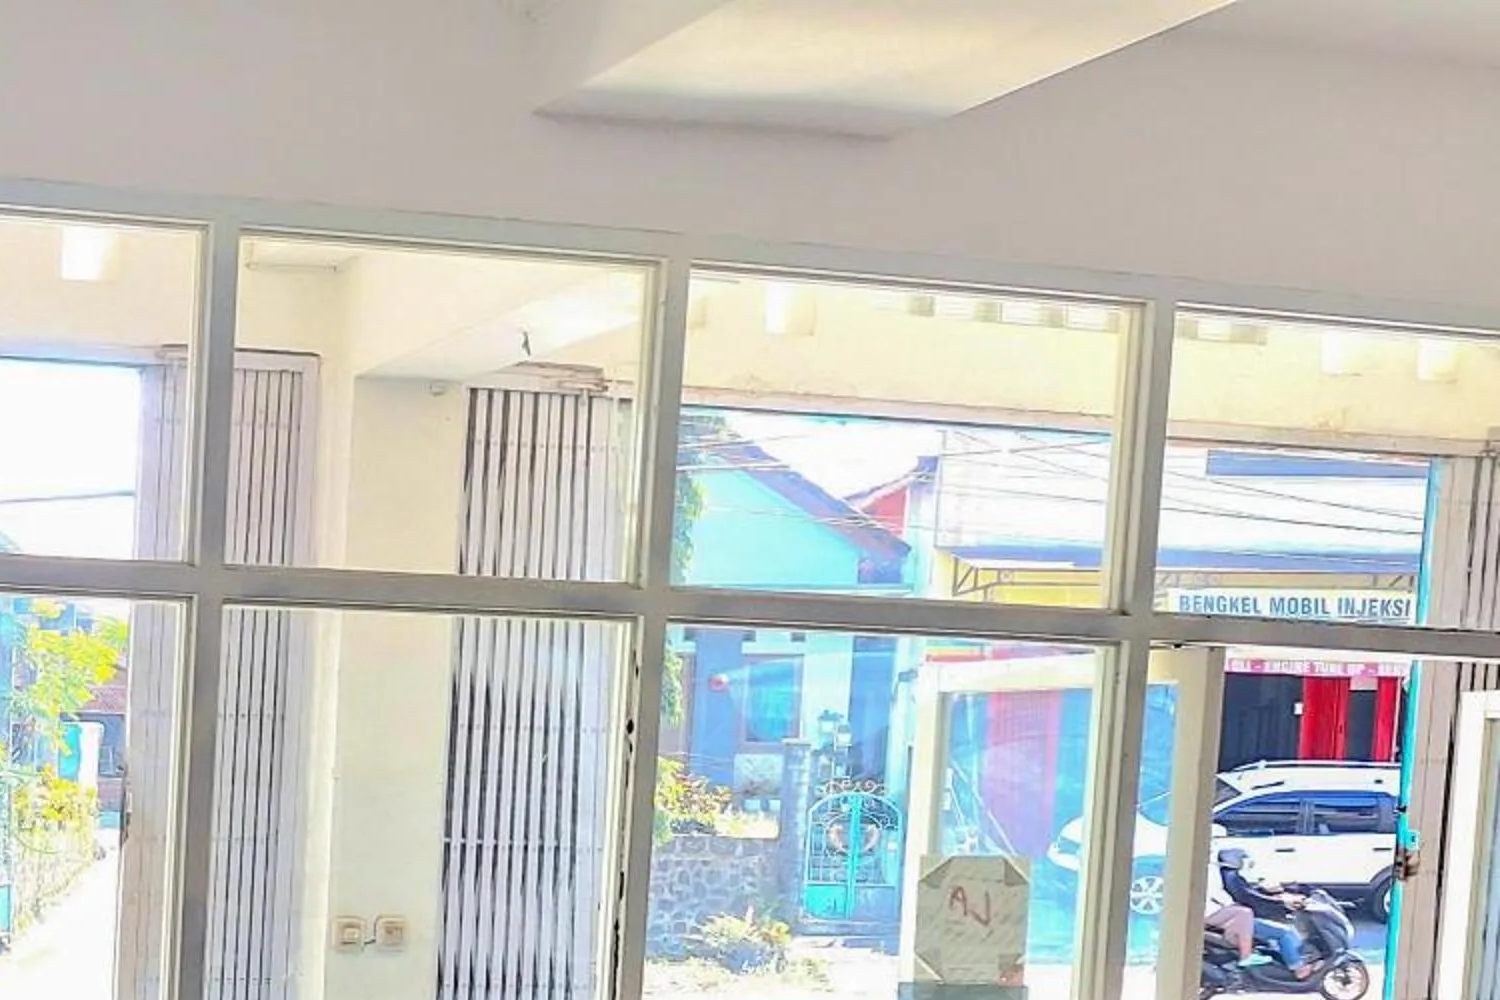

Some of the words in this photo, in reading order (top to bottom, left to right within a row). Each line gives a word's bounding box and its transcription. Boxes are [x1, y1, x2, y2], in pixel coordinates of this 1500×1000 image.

[1179, 595, 1262, 614] BENGKEL
[1269, 597, 1331, 616] MOBIL
[1337, 597, 1411, 618] INJEKSI
